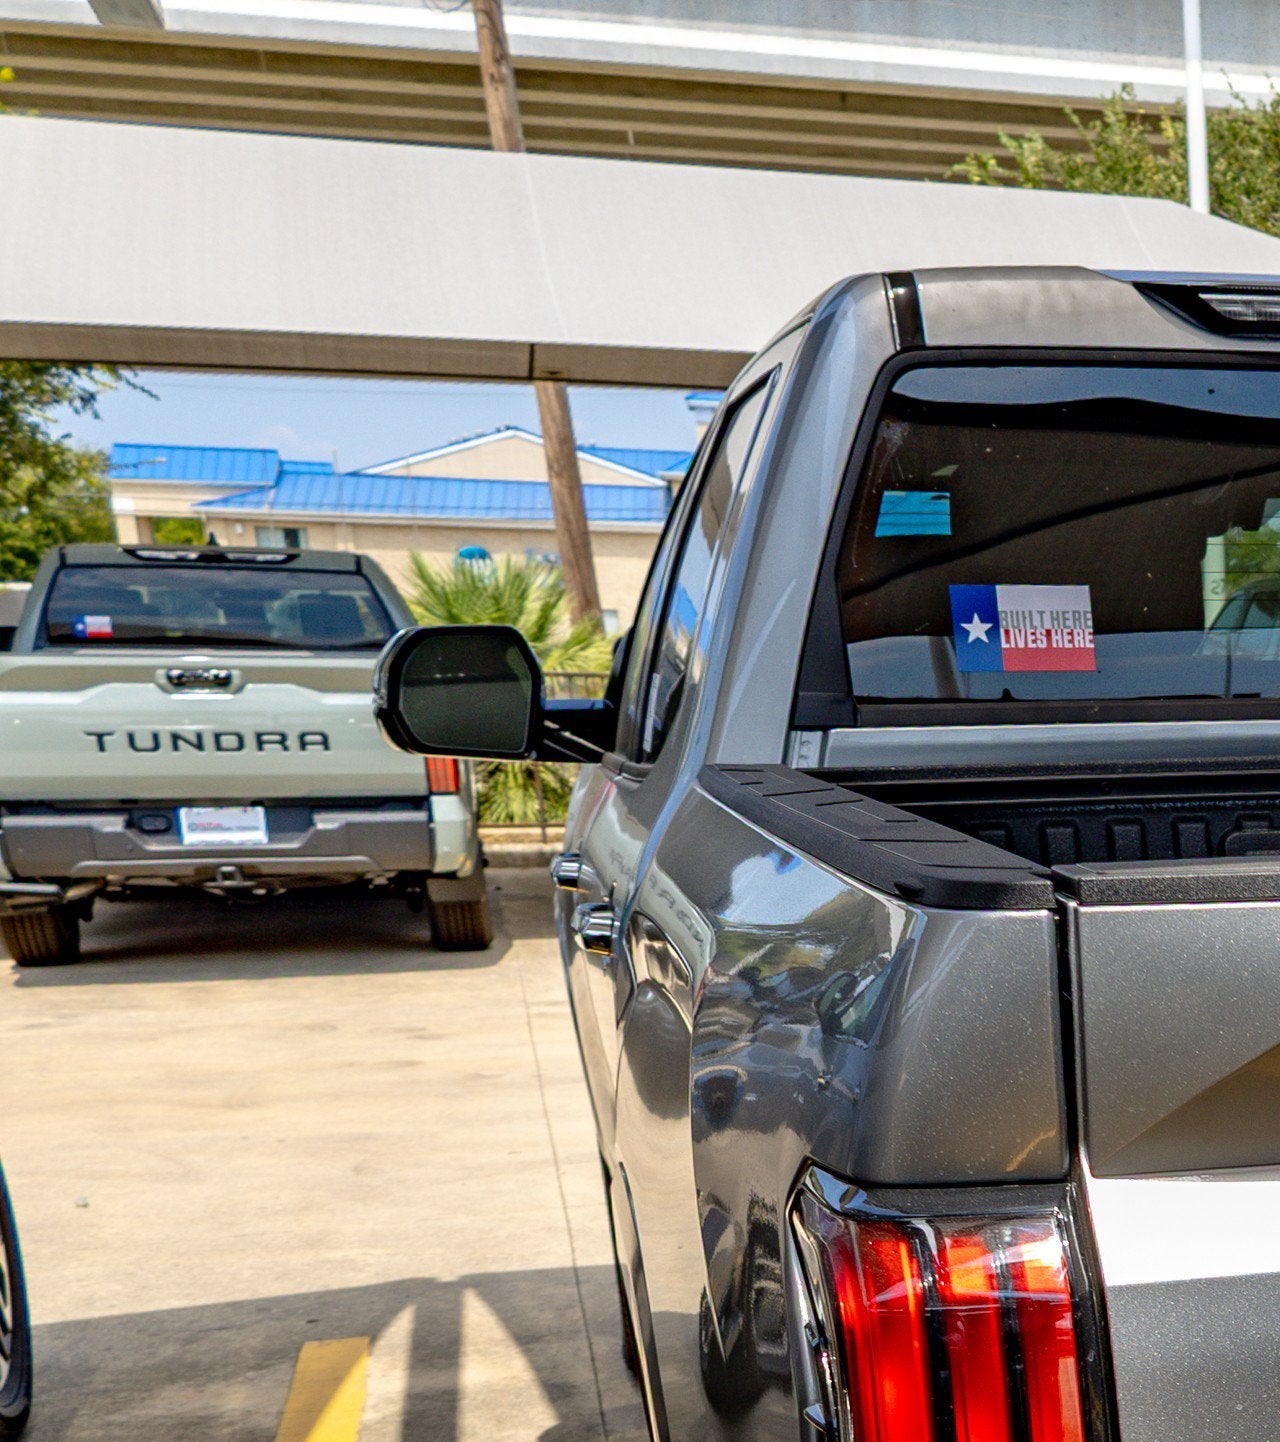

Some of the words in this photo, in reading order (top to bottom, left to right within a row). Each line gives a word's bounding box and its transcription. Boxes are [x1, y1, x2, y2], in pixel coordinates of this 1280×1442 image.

[999, 610, 1046, 629] BUILT
[1050, 610, 1092, 629] HERE
[1001, 629, 1047, 648] LIVES
[1051, 629, 1094, 648] HERE
[83, 730, 331, 752] TUNDRA
